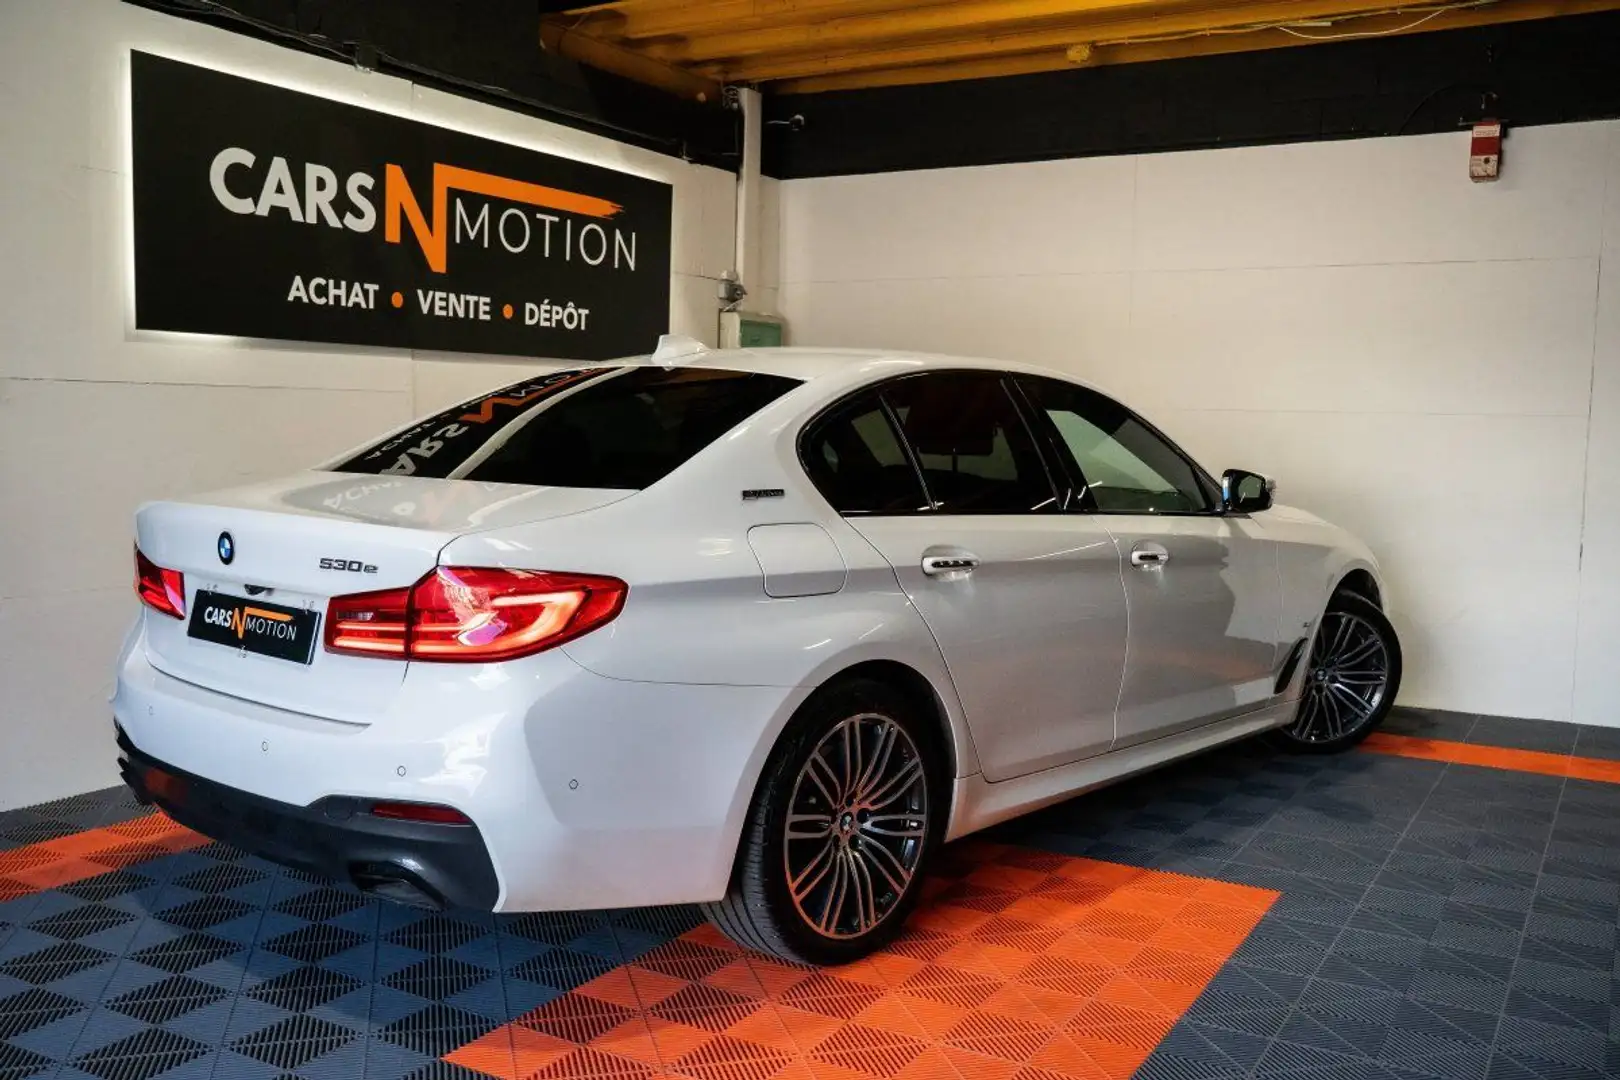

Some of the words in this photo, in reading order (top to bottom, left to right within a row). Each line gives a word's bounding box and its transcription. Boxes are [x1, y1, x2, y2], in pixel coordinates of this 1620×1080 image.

[287, 275, 380, 310] ACHAT
[417, 288, 492, 321] VENTE
[524, 298, 590, 331] DÉPÔT
[319, 557, 379, 574] 530e
